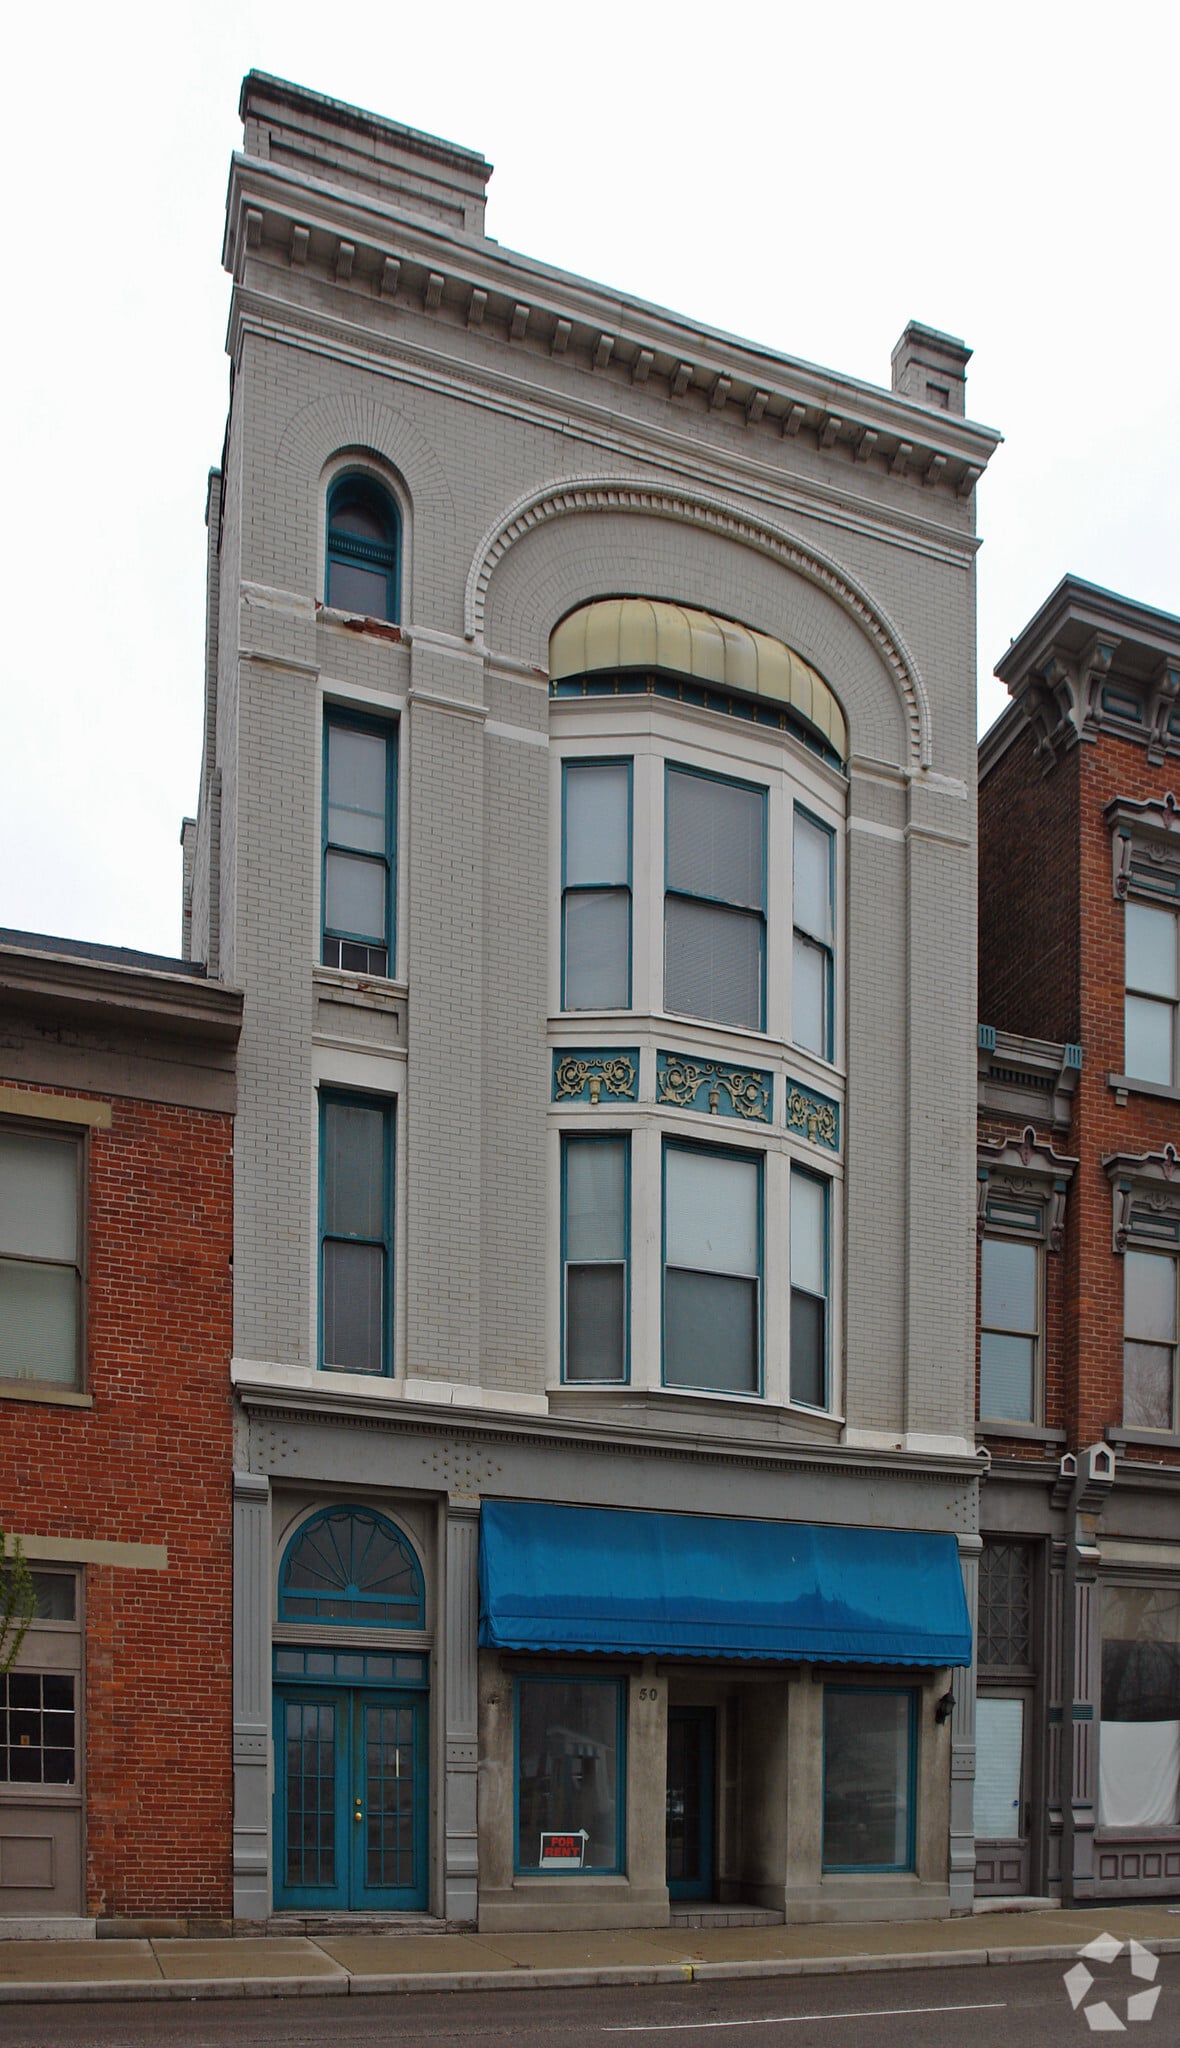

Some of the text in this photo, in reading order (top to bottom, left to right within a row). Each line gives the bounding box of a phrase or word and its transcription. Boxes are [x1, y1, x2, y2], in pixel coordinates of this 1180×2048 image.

[639, 1687, 658, 1701] 50
[551, 1836, 575, 1847] FOR
[544, 1847, 580, 1857] RENT
